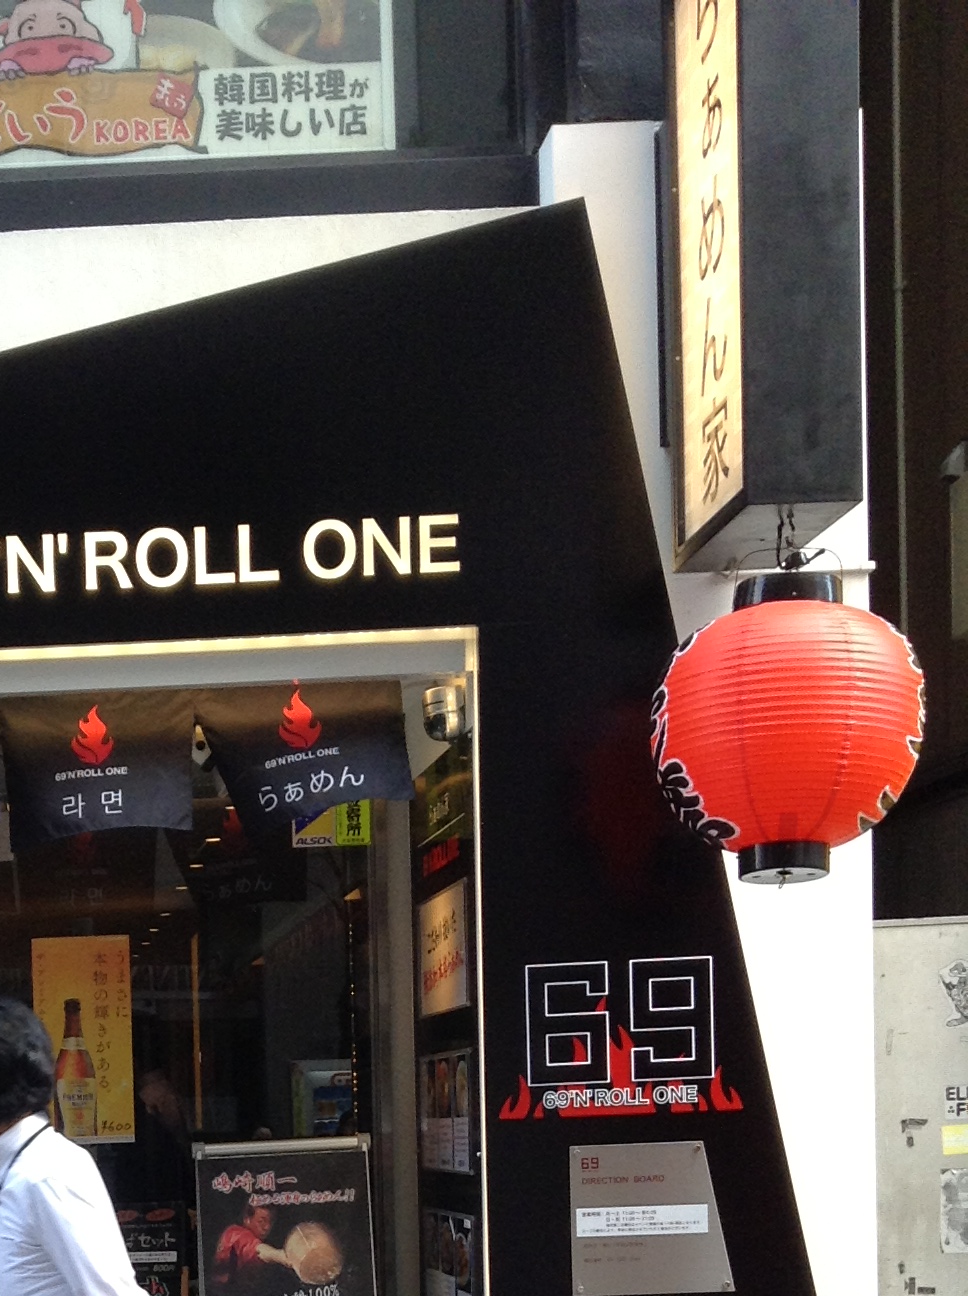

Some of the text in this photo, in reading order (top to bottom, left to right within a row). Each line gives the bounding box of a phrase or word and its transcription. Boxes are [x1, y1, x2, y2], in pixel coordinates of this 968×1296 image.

[214, 70, 370, 106] 韓国料理が
[94, 117, 193, 145] KOREA
[215, 105, 368, 141] 美味しい店
[303, 513, 461, 581] ONE
[316, 746, 340, 758] ONE
[105, 766, 128, 776] ONE
[258, 765, 365, 812] らぁめん
[525, 956, 715, 1087] 69
[653, 1085, 698, 1103] ONE
[946, 1086, 968, 1101] EL
[581, 1157, 599, 1170] 69
[211, 1171, 298, 1194] 嶋崎順一
[633, 1174, 665, 1183] BOARD
